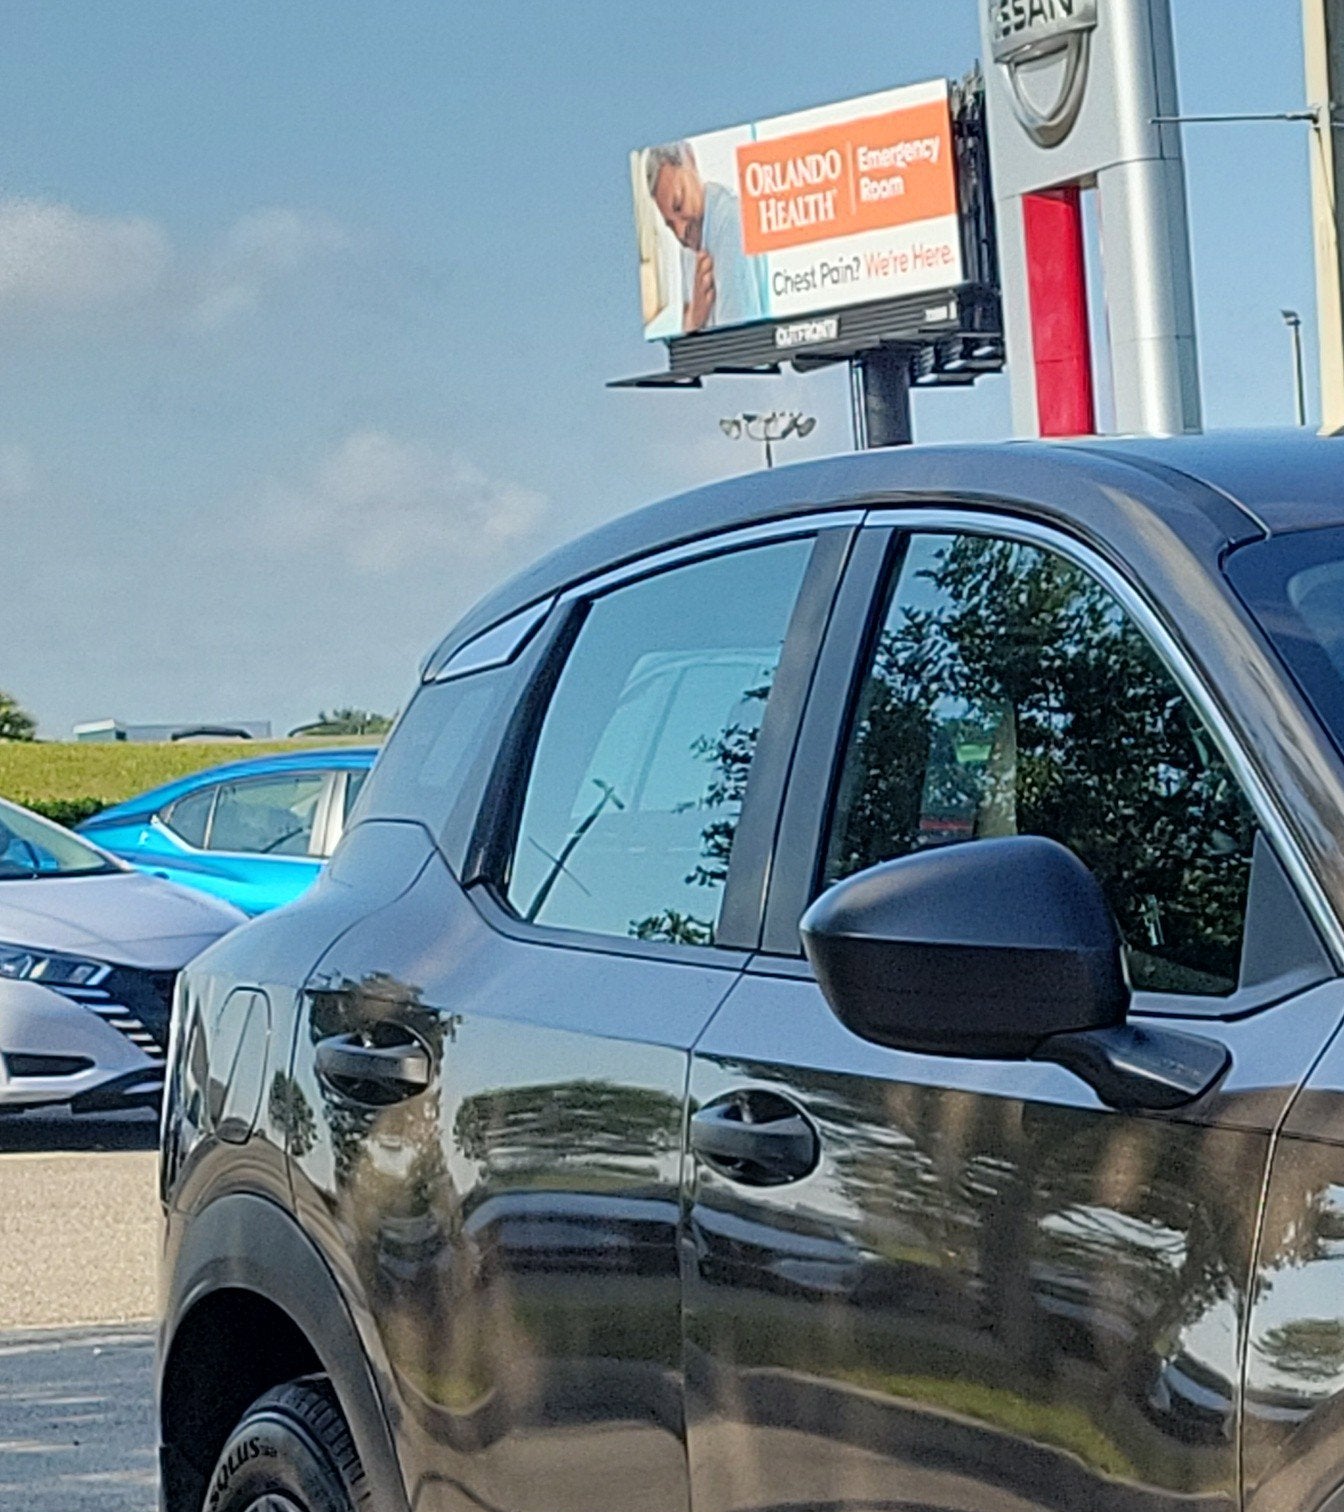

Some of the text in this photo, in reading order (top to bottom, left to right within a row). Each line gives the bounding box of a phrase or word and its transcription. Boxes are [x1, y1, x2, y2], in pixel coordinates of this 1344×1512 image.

[745, 149, 842, 197] ORLANDO
[857, 136, 941, 172] Emergency
[859, 175, 905, 203] Room
[758, 190, 836, 234] HEALTH
[773, 242, 956, 296] Chest Pain? We're Here.
